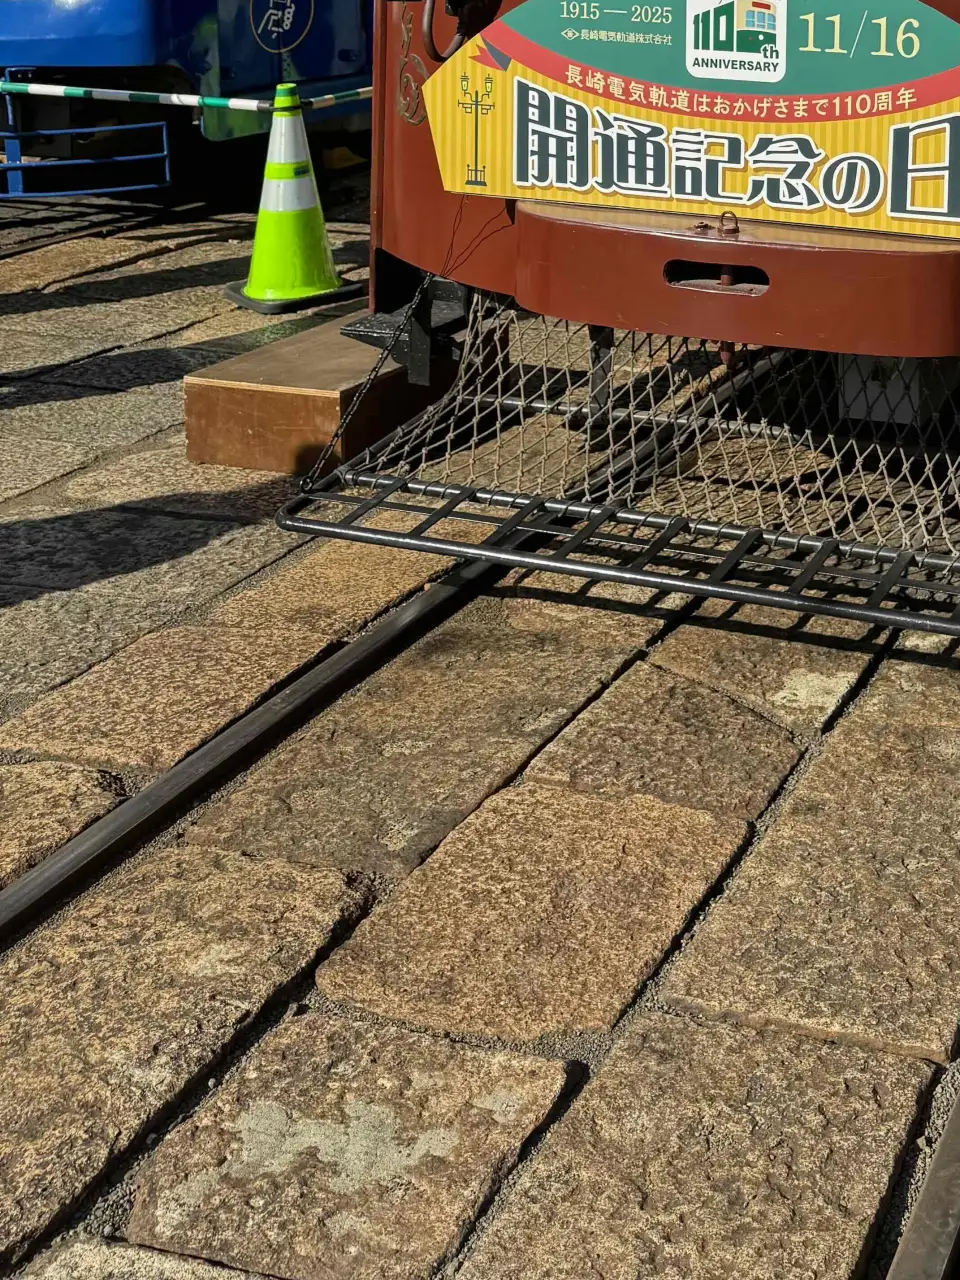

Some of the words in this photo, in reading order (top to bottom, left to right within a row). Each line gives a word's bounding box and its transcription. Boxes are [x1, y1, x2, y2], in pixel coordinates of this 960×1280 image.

[580, 28, 672, 46] 長崎電気軌道株式会社
[799, 10, 920, 58] 11/16
[692, 57, 779, 72] ANNIVERSARY
[566, 64, 918, 117] 長崎電気軌道はおかげさまで110周年
